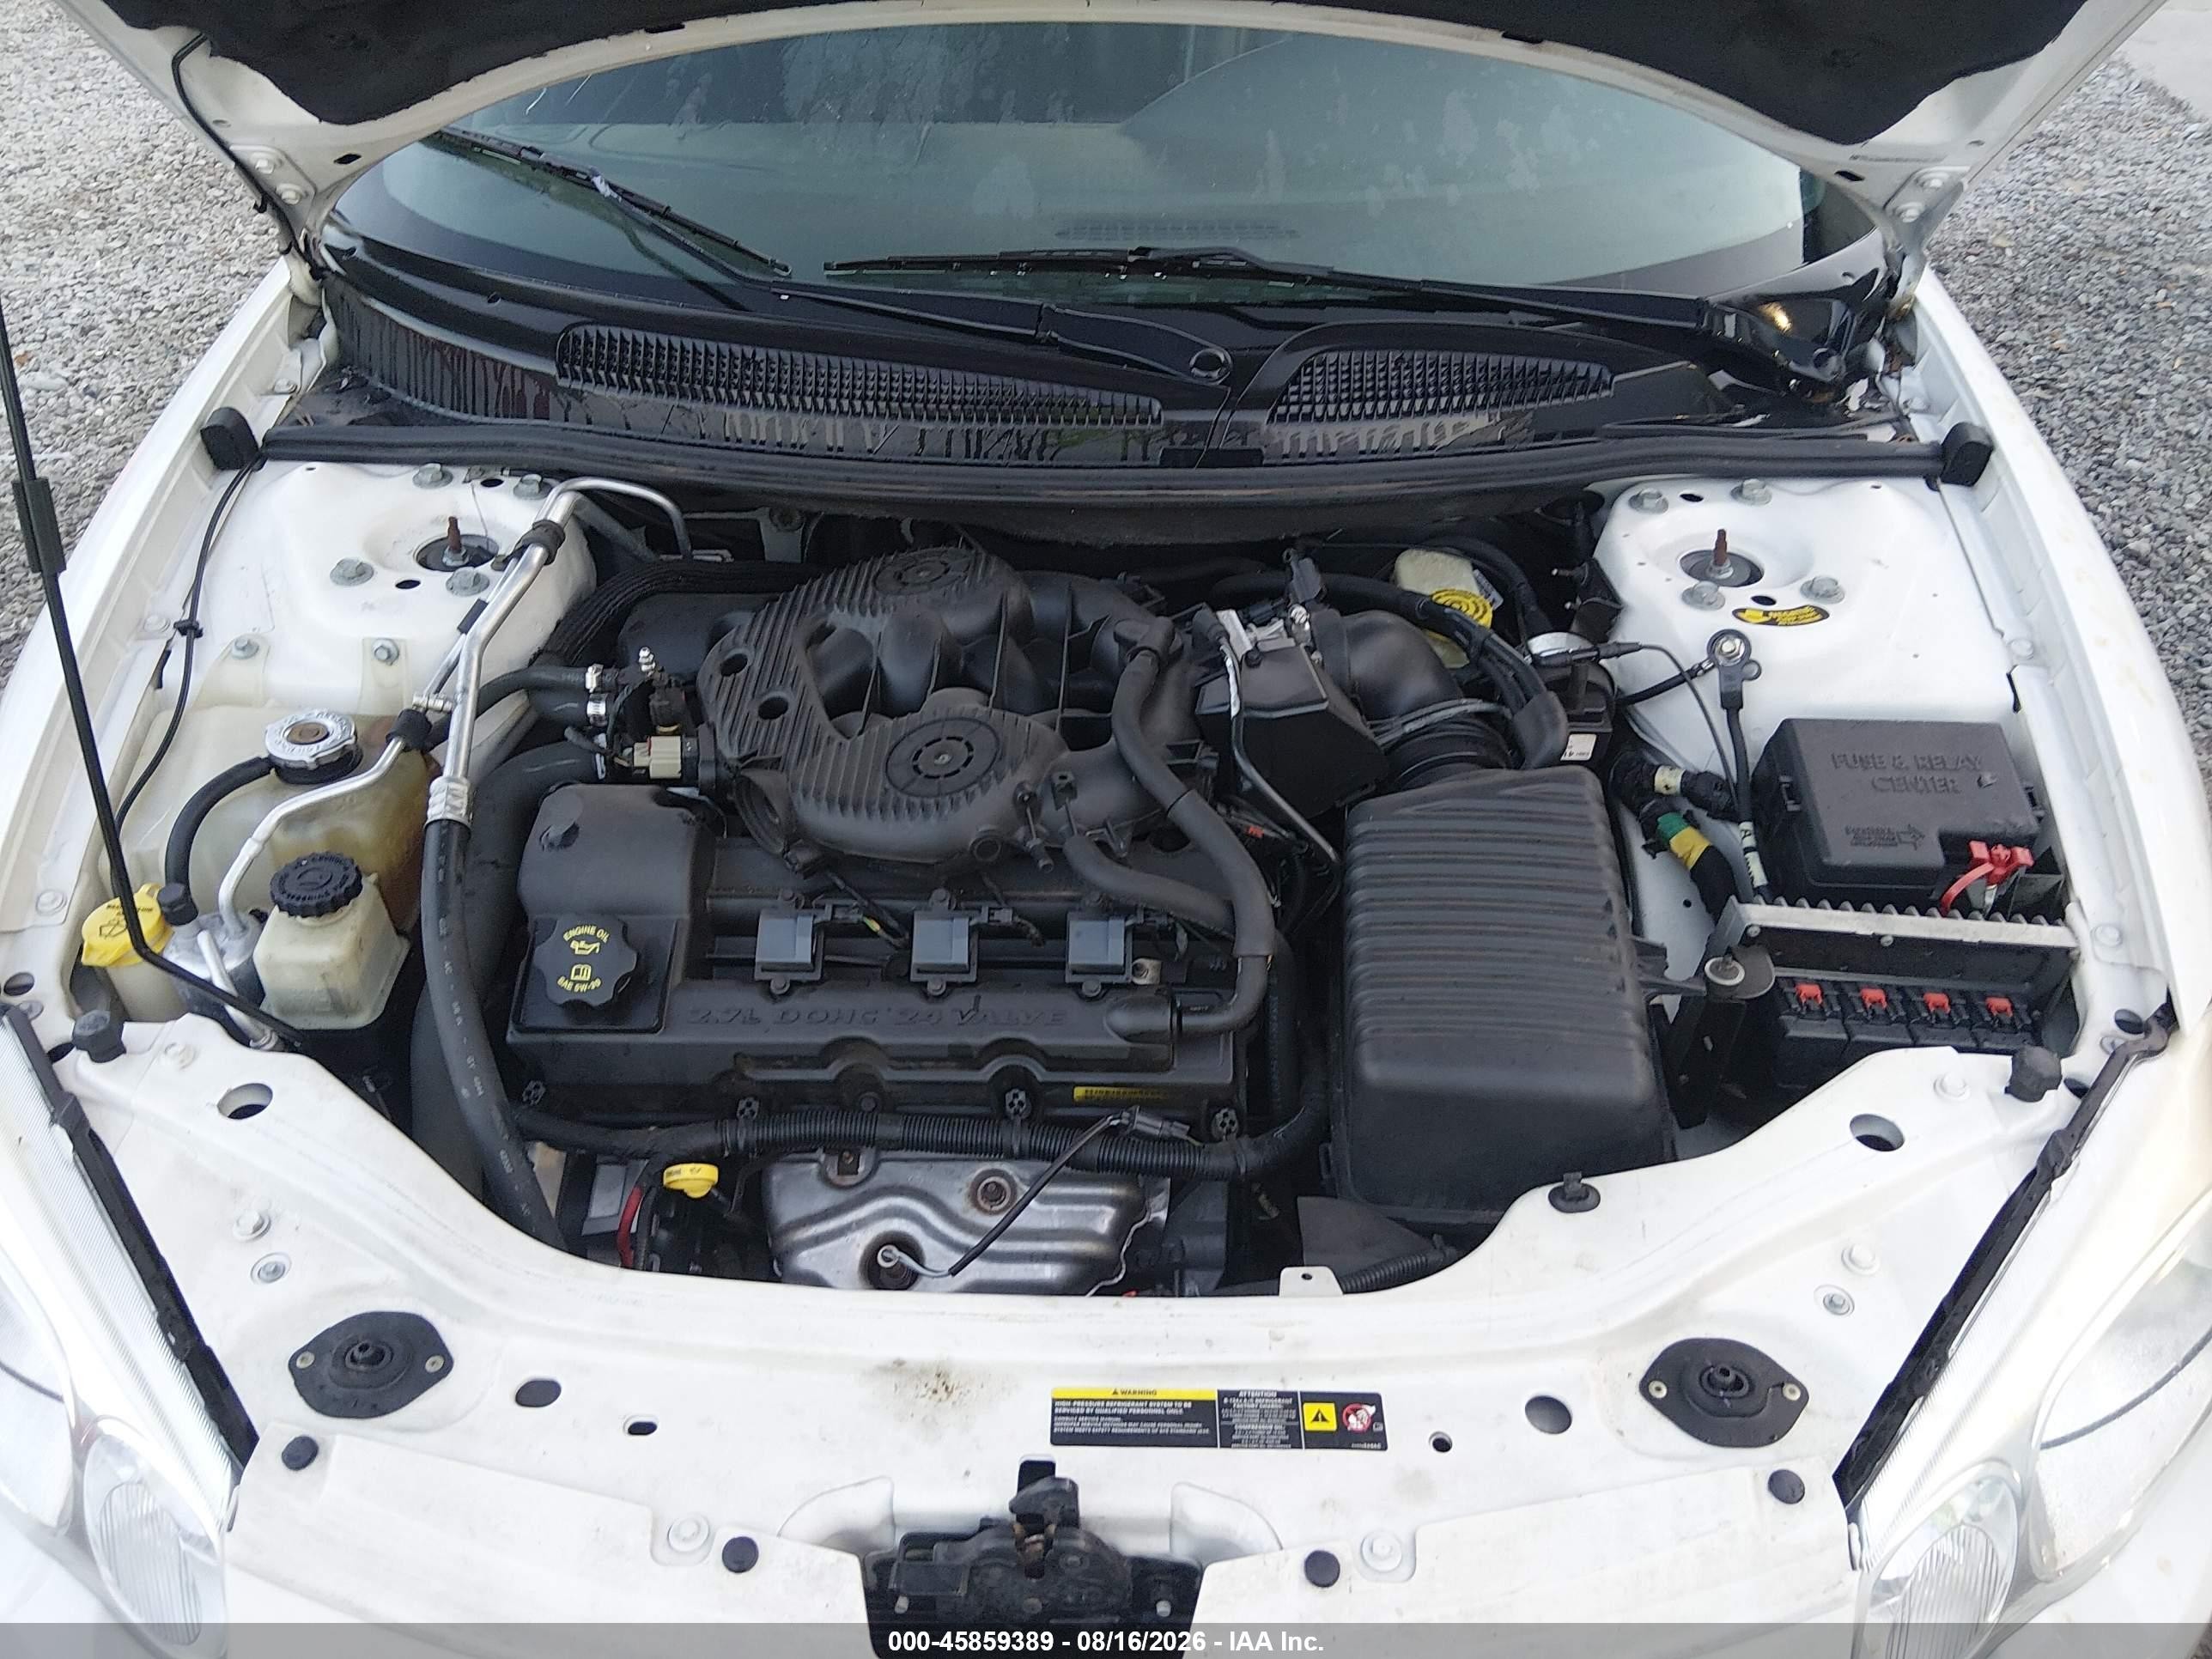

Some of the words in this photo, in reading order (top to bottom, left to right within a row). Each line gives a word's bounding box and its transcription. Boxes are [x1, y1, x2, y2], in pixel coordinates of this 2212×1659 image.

[1830, 752, 1887, 770] FUSE
[1892, 755, 1907, 769] &
[1913, 753, 1982, 771] RELAY
[1872, 775, 1961, 794] CENTER
[563, 925, 597, 942] ENGINE
[596, 928, 611, 944] OIL
[556, 975, 574, 992] SAE
[689, 1007, 762, 1024] 2.7L
[774, 1008, 878, 1024] DOHC
[893, 1008, 943, 1025] 24
[953, 1008, 1070, 1026] VALVE
